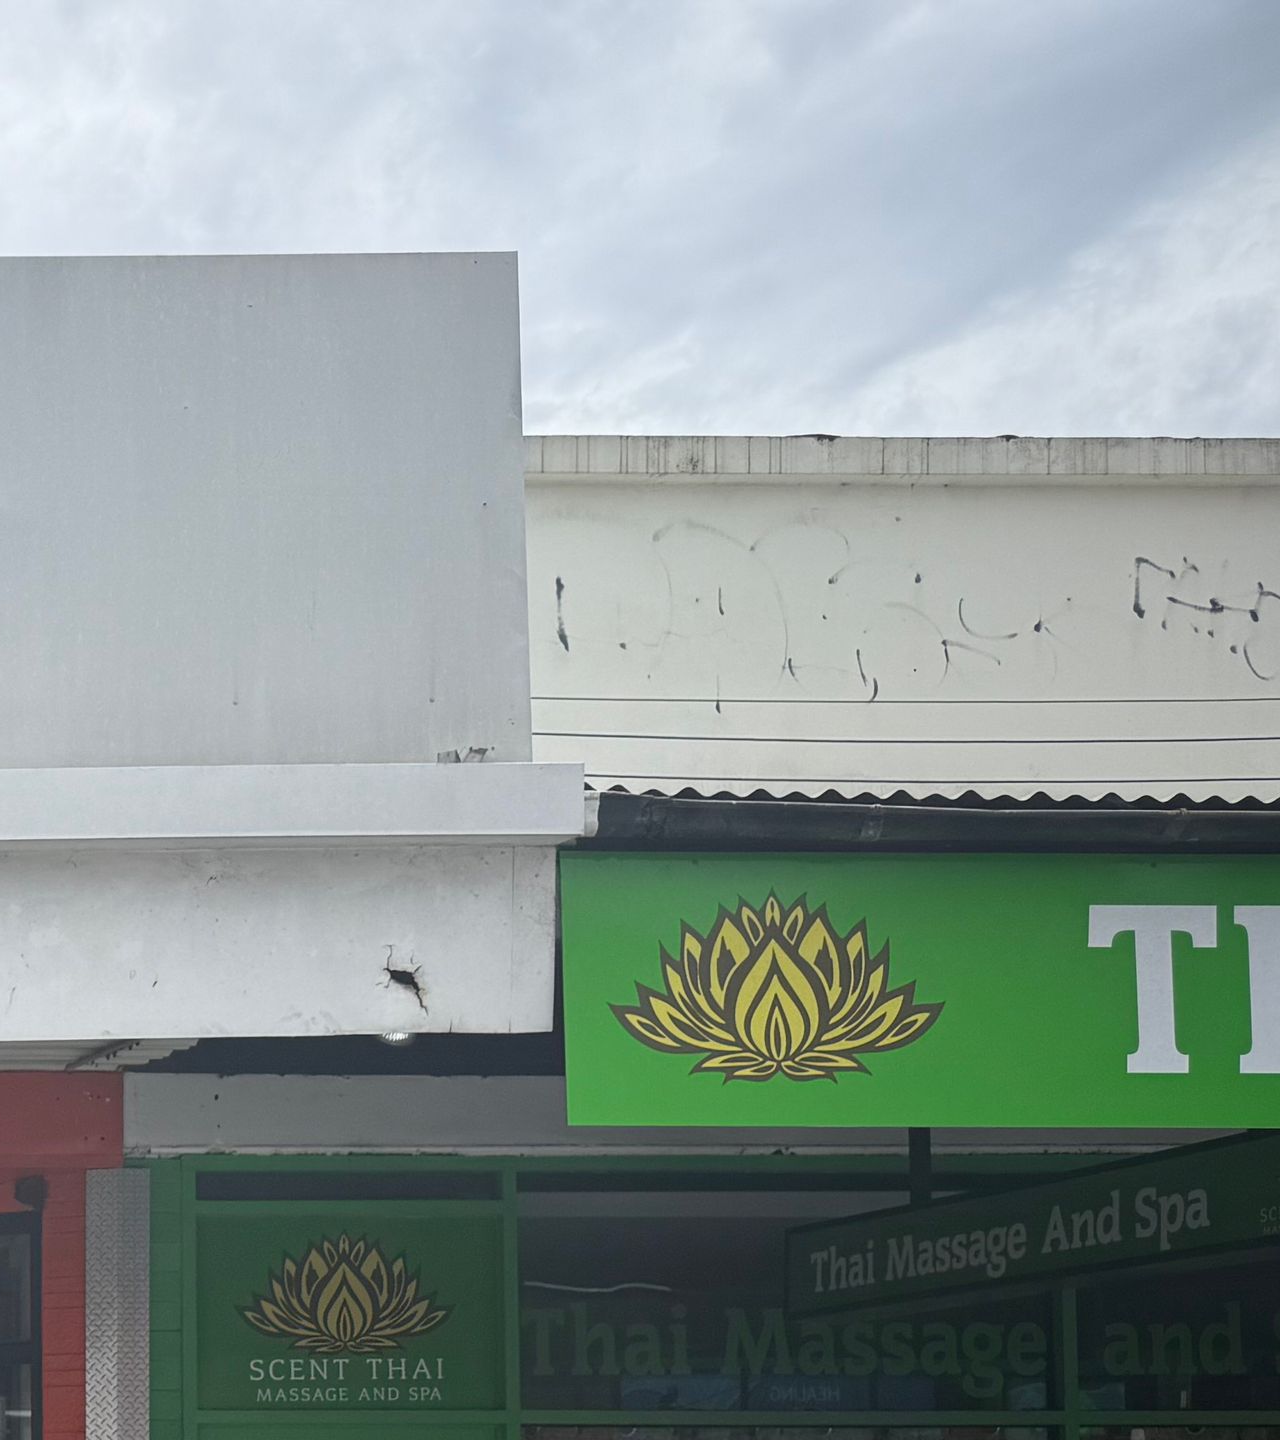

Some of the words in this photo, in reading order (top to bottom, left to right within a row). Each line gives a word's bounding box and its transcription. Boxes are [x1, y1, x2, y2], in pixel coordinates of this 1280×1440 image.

[809, 1239, 876, 1293] Thai
[885, 1221, 1028, 1280] Massage
[1041, 1190, 1122, 1254] And
[1134, 1185, 1211, 1251] Spa
[248, 1358, 350, 1381] SCENT
[366, 1358, 445, 1381] THAI
[522, 1302, 692, 1377] Thai
[721, 1306, 1047, 1399] Massage
[1104, 1300, 1247, 1377] and
[256, 1387, 349, 1402] MASSAGE
[359, 1387, 400, 1402] AND
[408, 1387, 442, 1402] SPA
